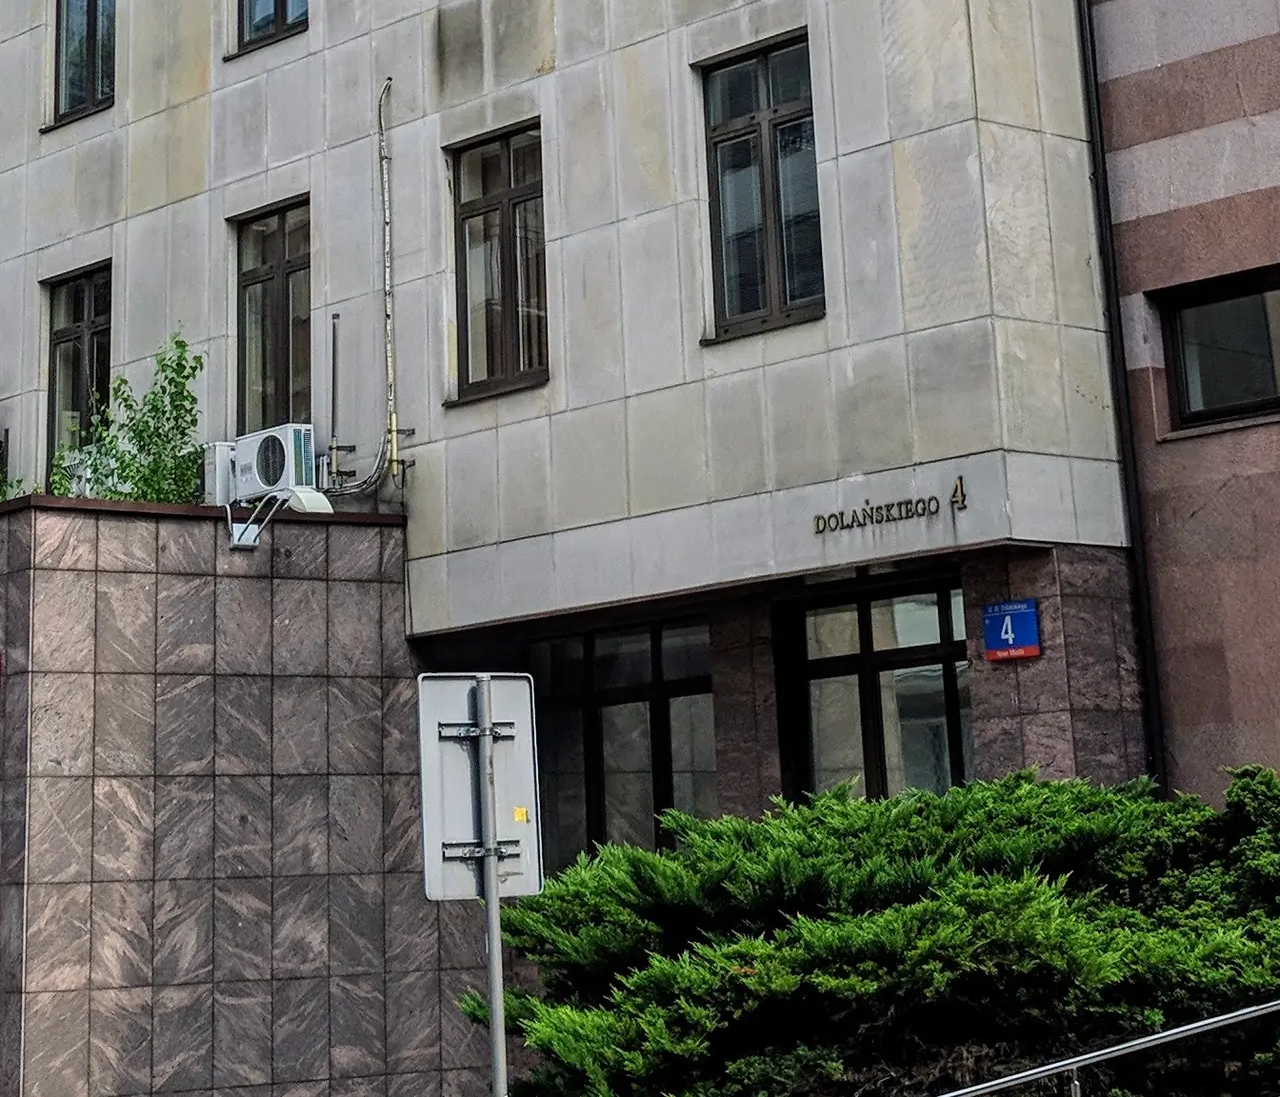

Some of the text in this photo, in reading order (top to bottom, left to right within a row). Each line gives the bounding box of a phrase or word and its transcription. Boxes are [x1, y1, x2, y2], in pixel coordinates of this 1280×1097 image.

[814, 475, 968, 534] DOLAŃSKIEGO 4
[1000, 615, 1015, 645] 4
